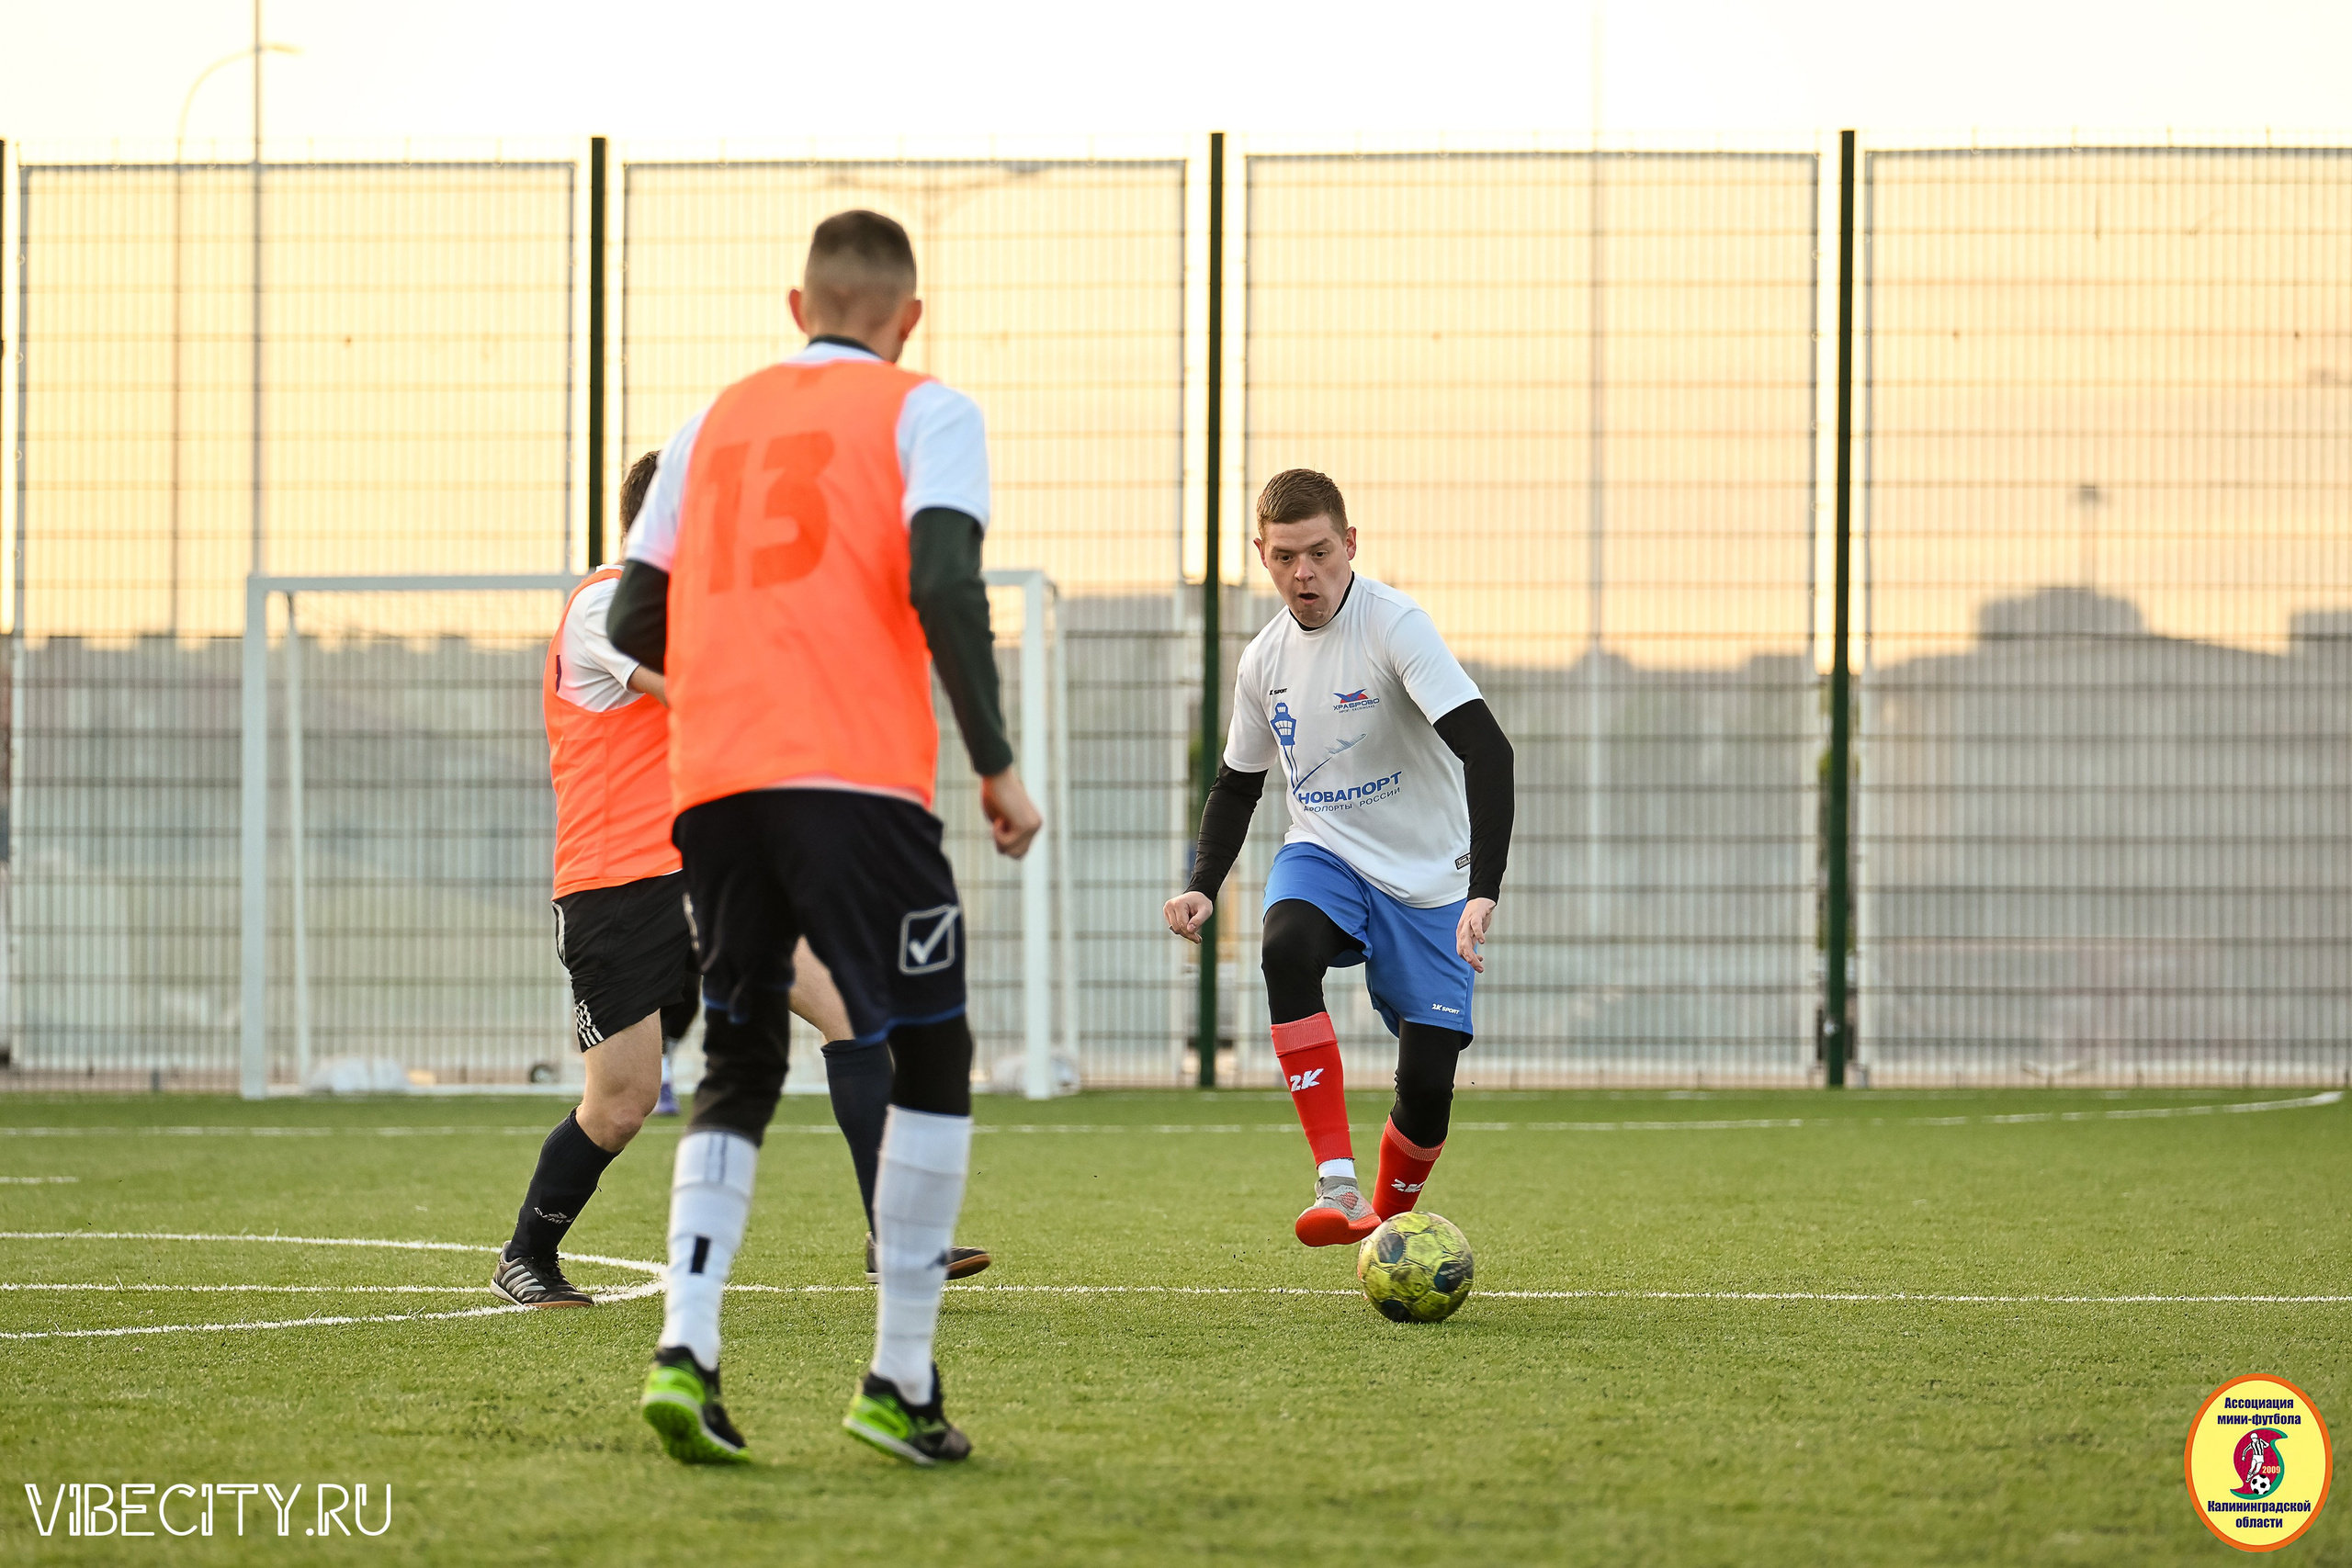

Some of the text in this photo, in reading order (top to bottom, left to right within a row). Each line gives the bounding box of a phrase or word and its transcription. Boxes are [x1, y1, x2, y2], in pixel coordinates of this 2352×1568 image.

[706, 431, 835, 594] 13
[1333, 697, 1380, 711] ХРАБРОВО
[1297, 771, 1402, 805] НОВАПОРТ
[1359, 786, 1401, 807] РОССИИ
[1442, 1006, 1461, 1015] SPORT
[1289, 1068, 1325, 1092] 2K
